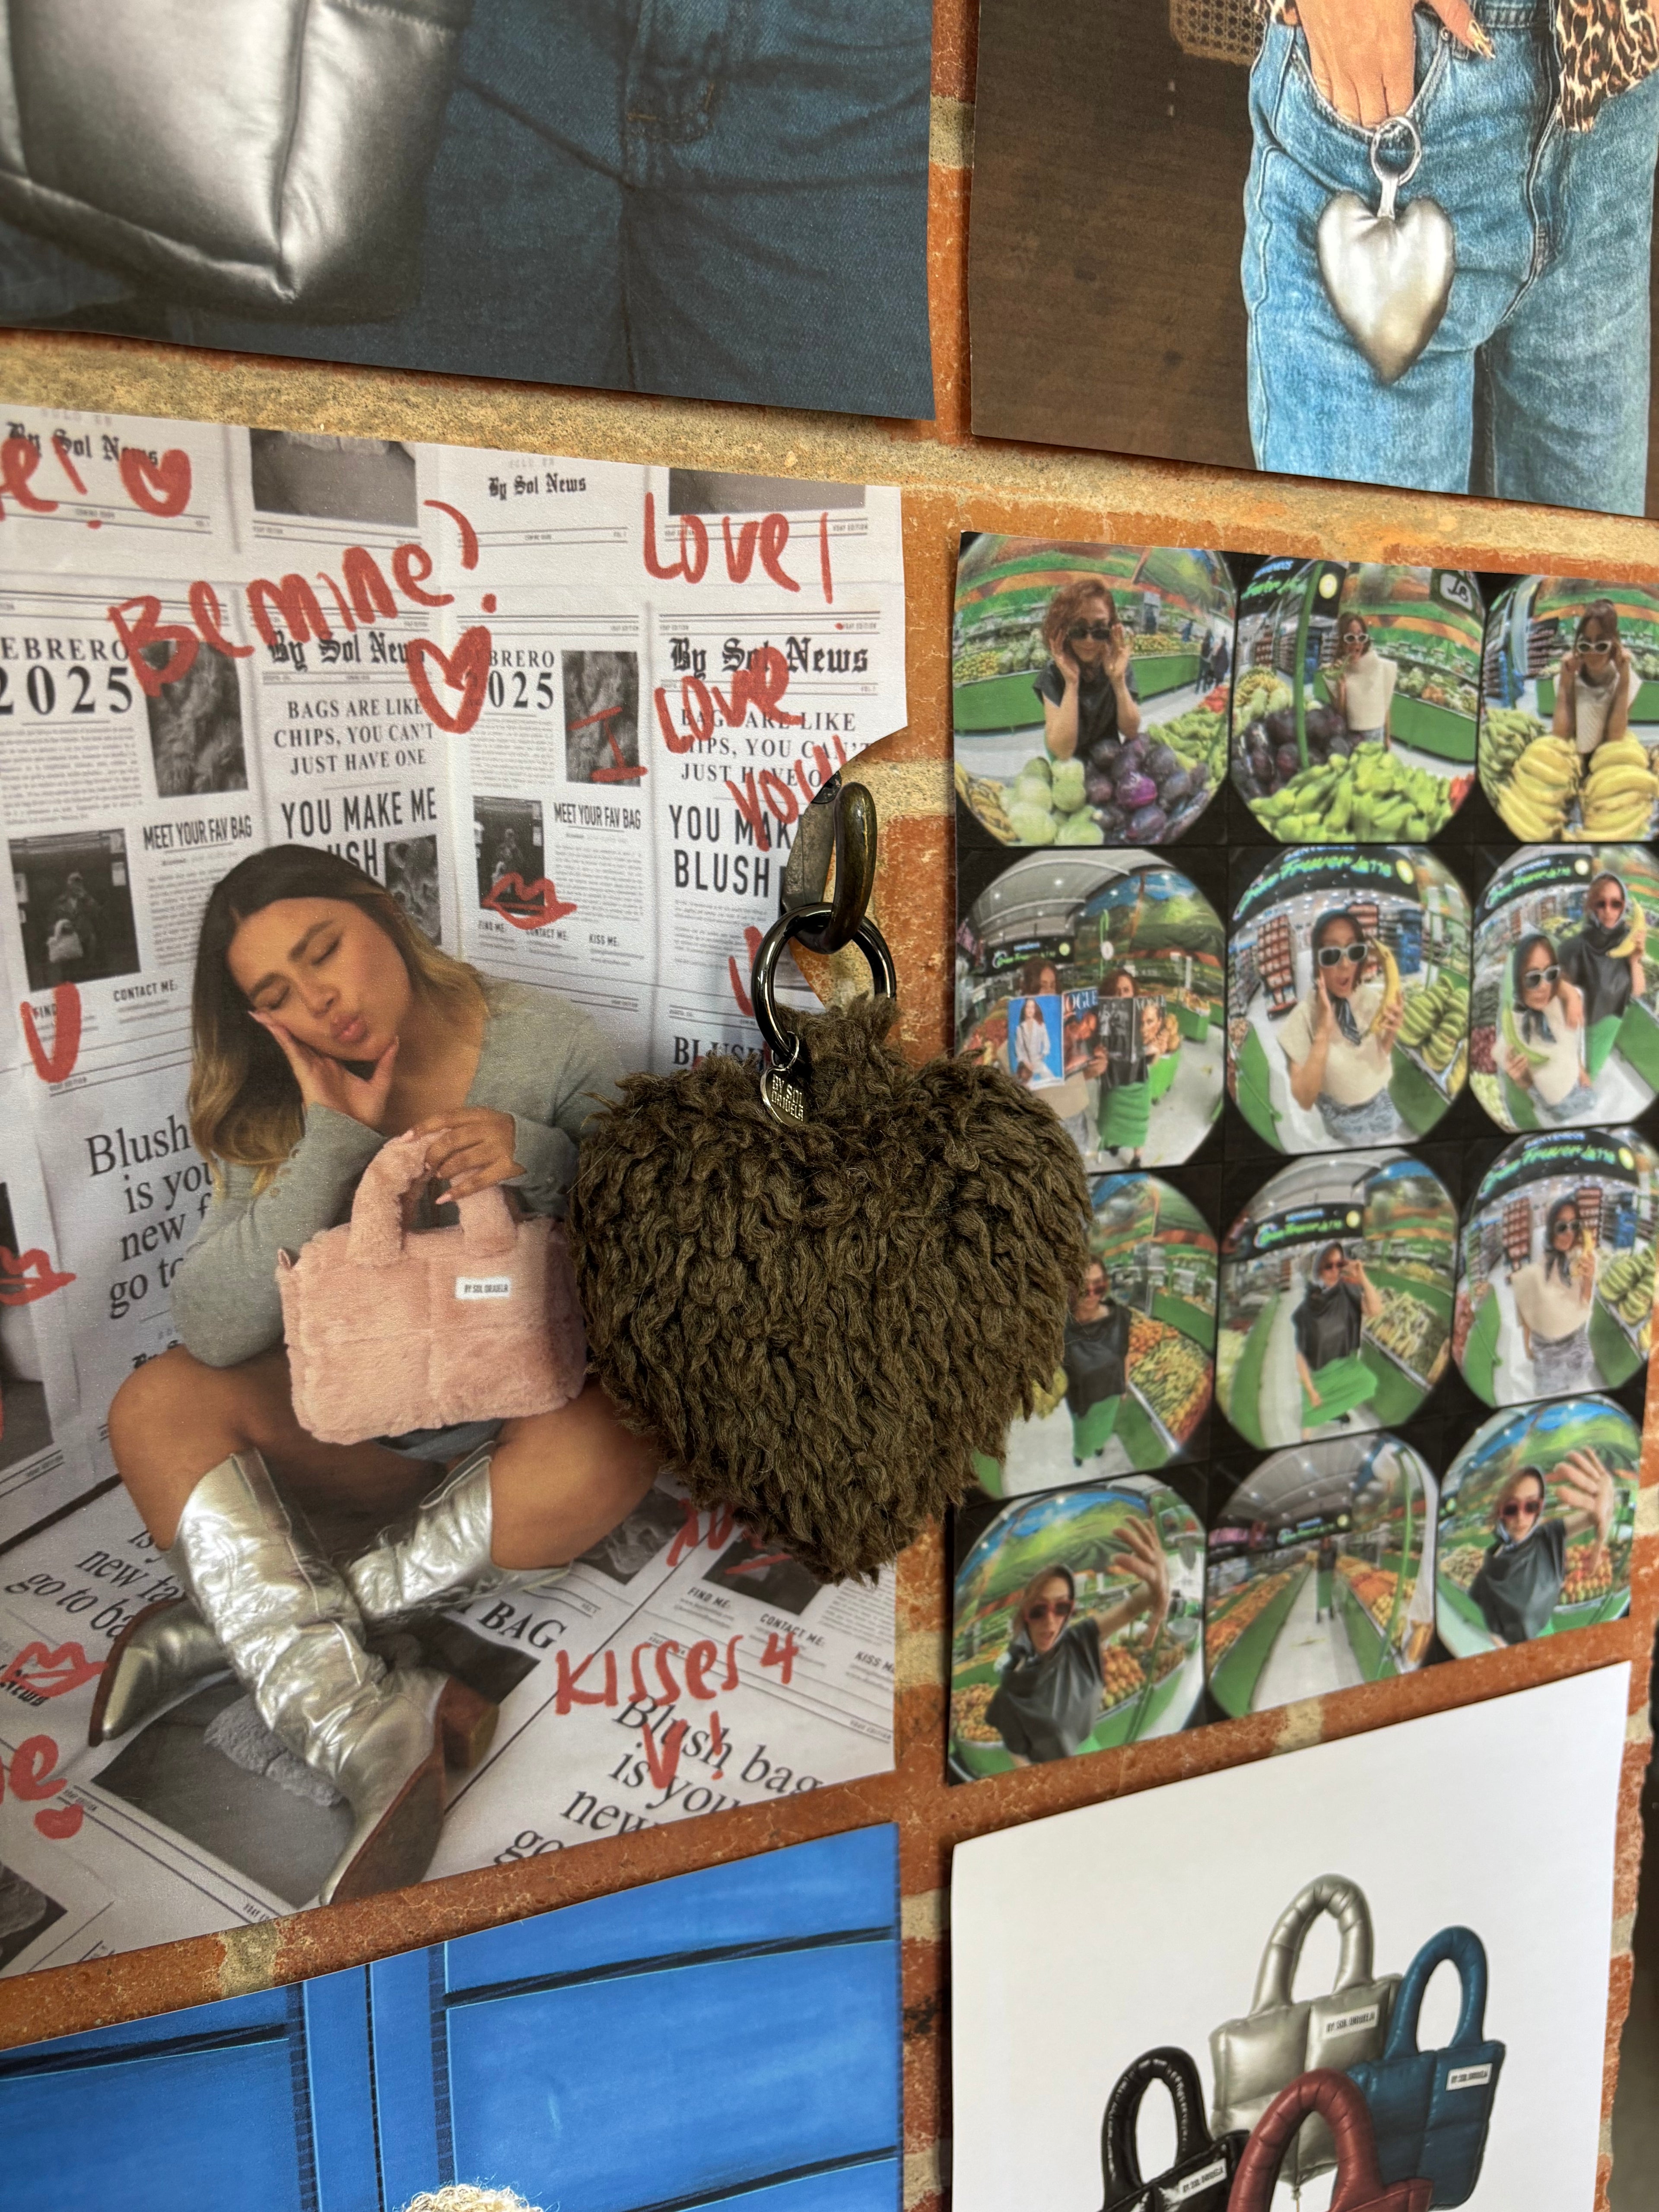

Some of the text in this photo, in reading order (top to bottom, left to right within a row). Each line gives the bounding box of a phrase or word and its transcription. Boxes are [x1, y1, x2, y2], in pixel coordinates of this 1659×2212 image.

[102, 433, 159, 466] Ns
[489, 472, 587, 501] By Sol News
[318, 633, 361, 664] Sol
[369, 630, 425, 664] New
[490, 650, 555, 668] BRERO
[669, 637, 707, 680] By
[786, 636, 868, 673] News
[488, 670, 554, 710] 025
[288, 699, 340, 719] BAGS
[346, 699, 380, 718] ARE
[801, 712, 856, 731] LIKE
[274, 722, 433, 748] CHIPS, YOU CAN'T
[745, 739, 791, 757] YOU
[290, 749, 426, 776] JUST HAVE ONE
[681, 763, 731, 782] JUST
[281, 787, 437, 839] YOU MAKE ME
[553, 802, 641, 830] MEET YOUR FAV BAG
[669, 805, 804, 850] YOU MAK
[143, 815, 252, 850] MEET YOUR FAV BAG
[674, 849, 770, 898] BLUSH
[113, 982, 157, 1002] CONTACT
[773, 1074, 802, 1108] BY SOL
[85, 1114, 191, 1177] Blush
[124, 1174, 154, 1214] is
[120, 1214, 186, 1262] new
[110, 1273, 147, 1319] go
[75, 1549, 185, 1601] new fa
[4, 1573, 134, 1639] go to ba
[688, 1586, 713, 1602] FIND
[478, 1600, 568, 1650] BAG
[760, 1613, 805, 1637] CONTACT
[760, 1632, 799, 1685] 4
[855, 1651, 882, 1667] KISS
[612, 1694, 734, 1770] Blush
[609, 1742, 652, 1788] is
